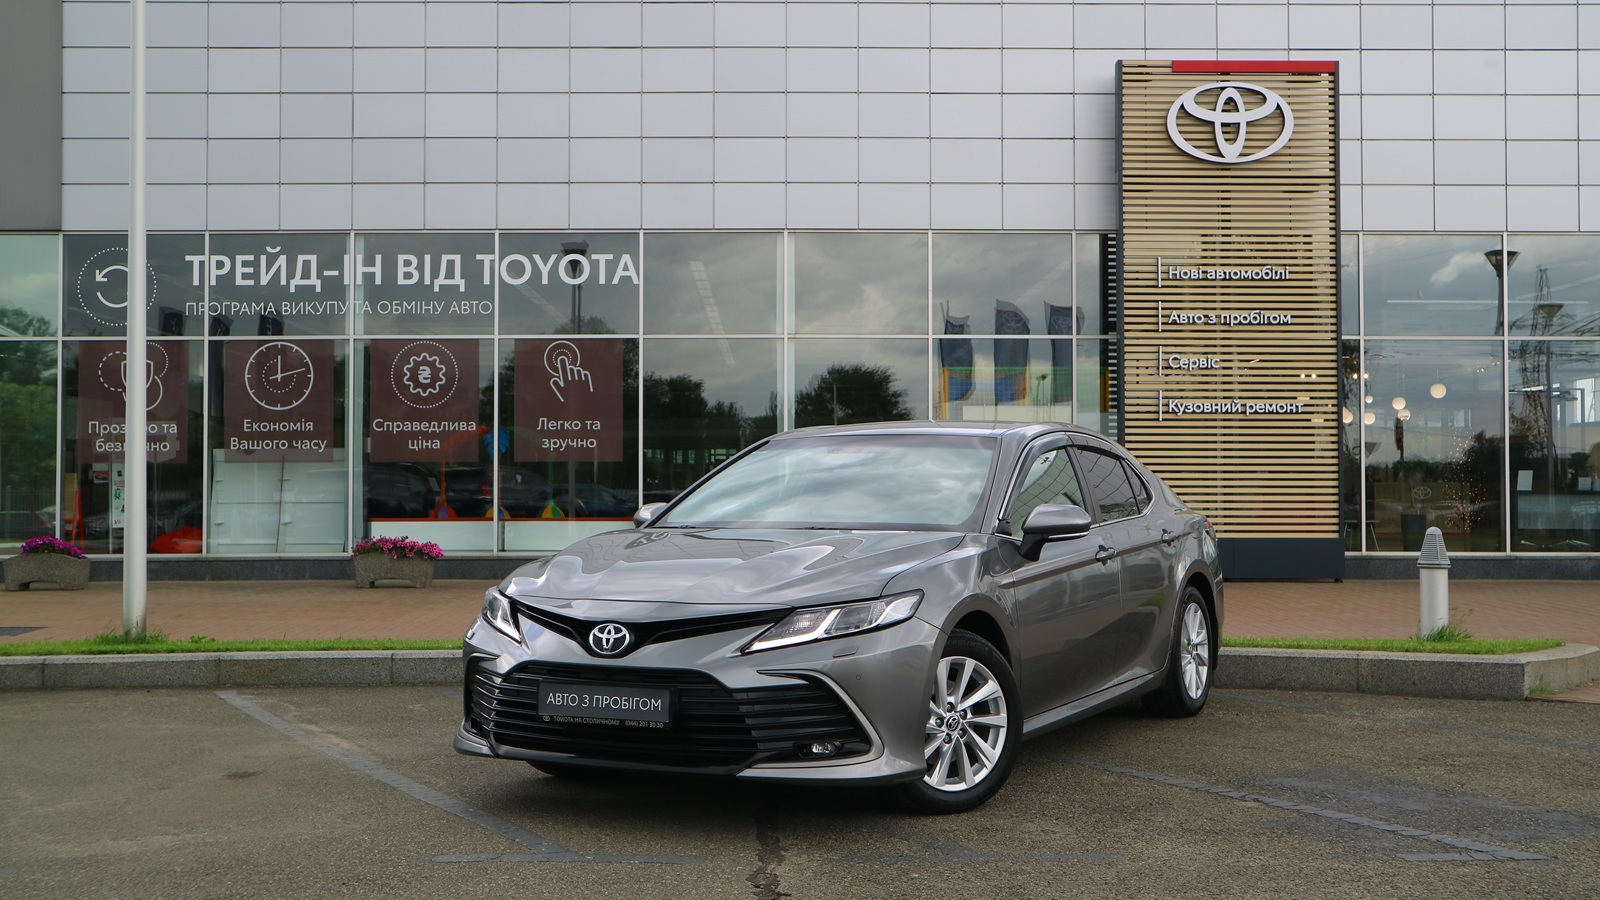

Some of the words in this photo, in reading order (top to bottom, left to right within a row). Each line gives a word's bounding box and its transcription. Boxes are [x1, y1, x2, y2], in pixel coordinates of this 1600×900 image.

[185, 246, 382, 292] ТРЕЙД-ІН
[397, 254, 465, 292] ВІД
[476, 253, 640, 285] TOYOTA
[1168, 266, 1203, 279] Нові
[1207, 266, 1290, 280] автомобілі
[186, 302, 276, 315] ПРОГРАМА
[282, 301, 348, 315] ВИКУПУ
[353, 300, 372, 314] ТА
[377, 300, 445, 315] ОБМІНУ
[449, 300, 493, 315] АВТО
[1168, 311, 1205, 324] Авто
[1208, 314, 1216, 324] з
[1220, 310, 1292, 327] пробігом
[1168, 355, 1220, 371] Сервіс
[1168, 399, 1242, 415] Кузовний
[1245, 402, 1304, 416] ремонт
[88, 421, 158, 436] Прозо
[162, 424, 177, 433] та
[243, 419, 314, 431] Економія
[372, 419, 477, 433] Справедлива
[537, 418, 581, 430] Легко
[585, 420, 601, 430] та
[230, 438, 289, 451] Вашого
[294, 440, 327, 452] часу
[408, 437, 441, 450] ціна
[541, 437, 597, 451] зручно
[546, 692, 579, 706] АВТО
[593, 695, 662, 711] ПРОБІГОМ
[582, 717, 620, 726] СТОЛИЧНОМУ
[625, 719, 639, 727] (044)
[639, 720, 648, 728] 201
